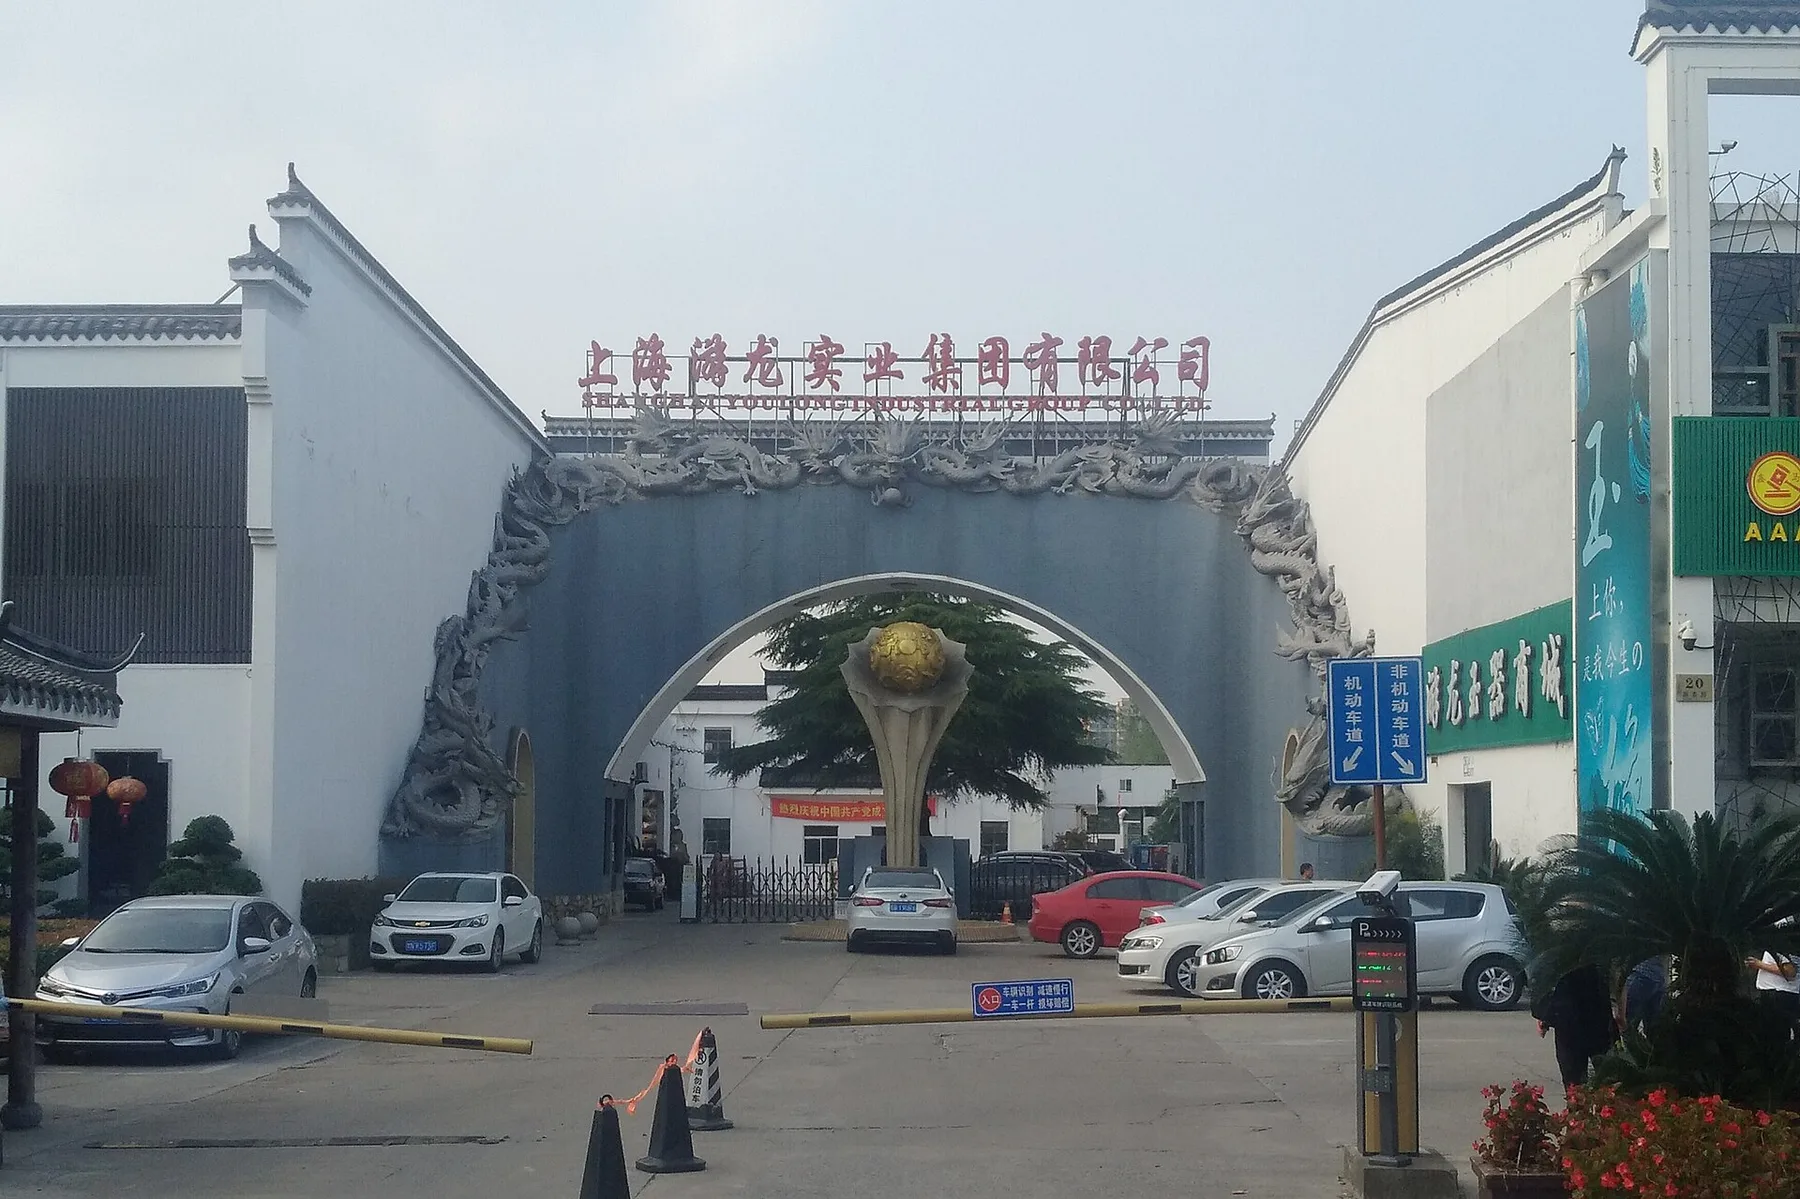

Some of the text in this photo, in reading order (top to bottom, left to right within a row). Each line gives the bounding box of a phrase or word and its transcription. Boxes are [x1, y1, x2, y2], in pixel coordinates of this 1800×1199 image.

[725, 394, 846, 411] YOULONG
[852, 396, 1003, 412] INDUSTRIAL
[1007, 396, 1091, 412] GROUP
[1685, 677, 1704, 689] 20
[1344, 676, 1363, 742] 机动车道
[1390, 664, 1410, 748] 非机动车道
[779, 803, 885, 818] 热烈庆祝中国共产党成
[981, 995, 999, 1005] 入口
[1003, 998, 1035, 1010] 一车一杆
